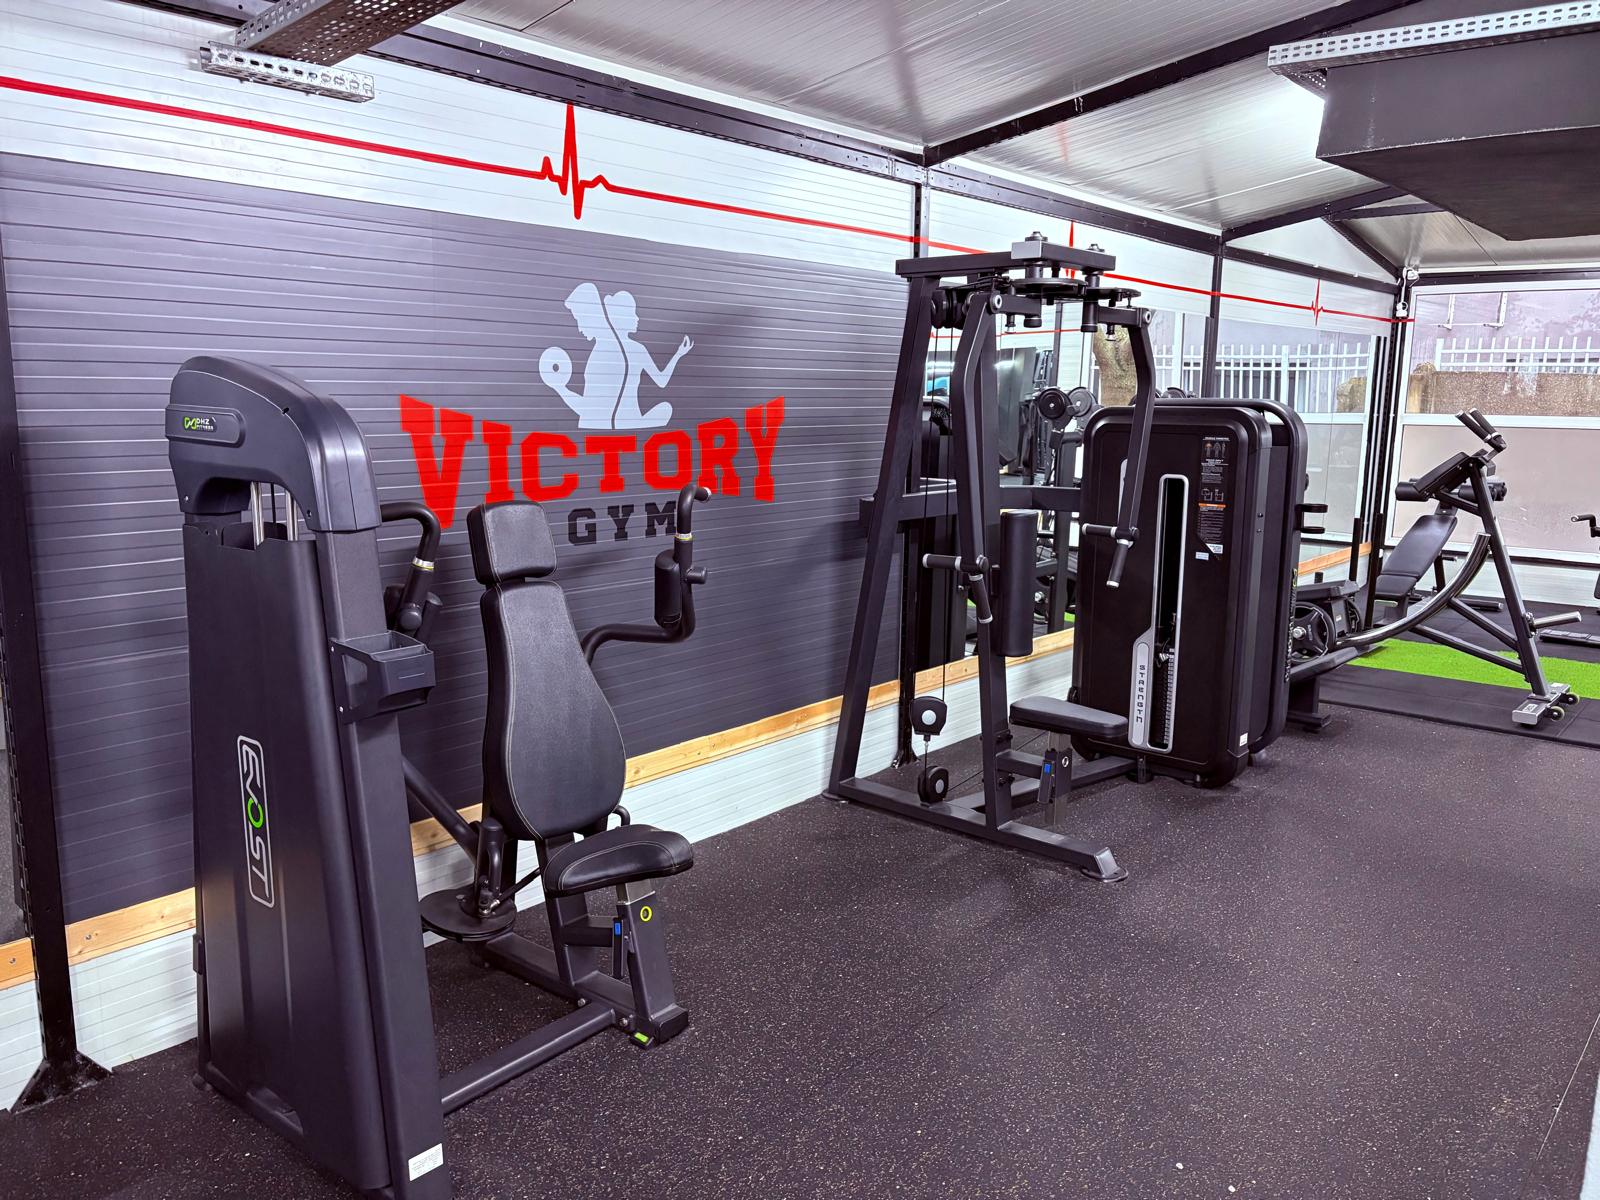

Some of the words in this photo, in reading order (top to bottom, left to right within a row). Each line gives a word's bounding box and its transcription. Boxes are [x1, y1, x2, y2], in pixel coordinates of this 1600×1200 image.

[196, 417, 210, 425] DHZ
[400, 394, 785, 529] VICTORY
[567, 500, 677, 546] GYM
[1136, 664, 1146, 723] STRENGTH
[242, 744, 270, 898] EVOST
